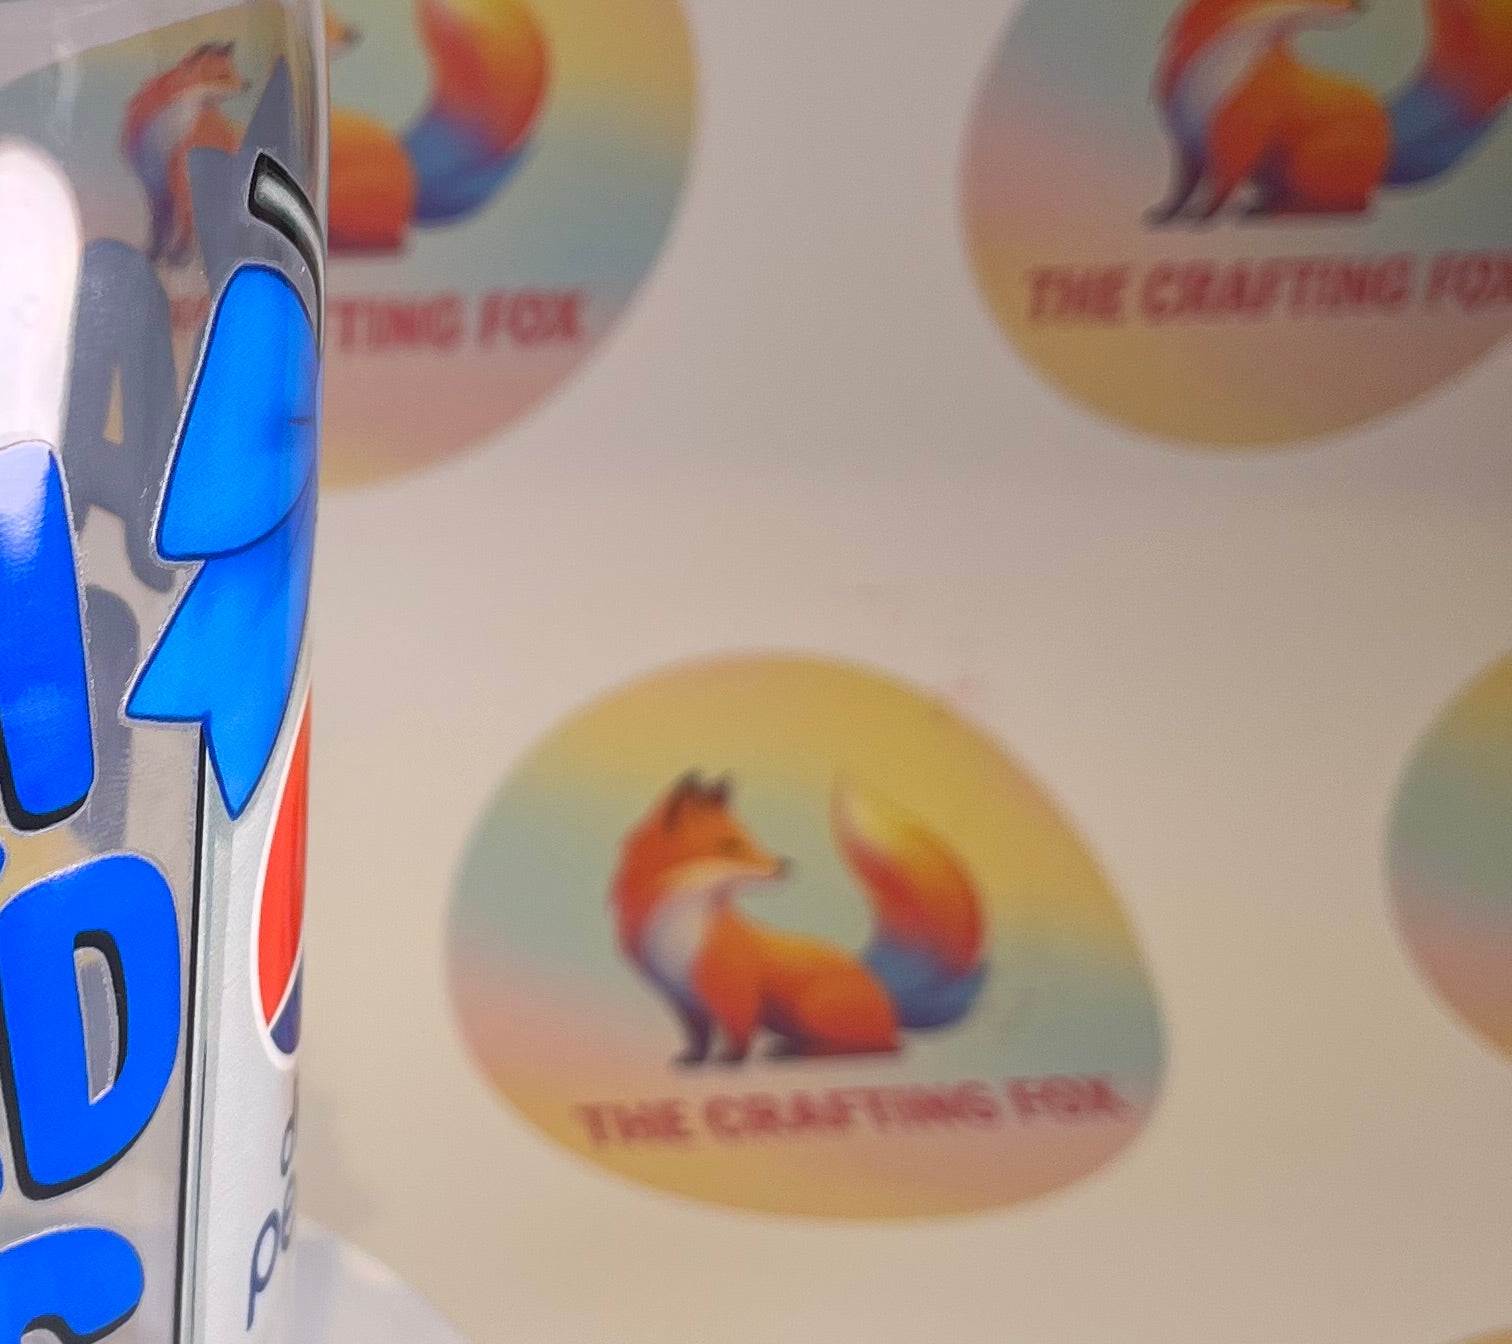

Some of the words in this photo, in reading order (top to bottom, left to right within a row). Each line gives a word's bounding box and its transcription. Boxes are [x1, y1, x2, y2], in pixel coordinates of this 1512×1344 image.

[476, 289, 588, 352] FOX
[1027, 265, 1131, 324] THE
[1138, 254, 1412, 322] CRAFTING
[577, 1098, 692, 1148] THE
[702, 1080, 1000, 1142] CRAFTING
[1006, 1074, 1138, 1123] FOX
